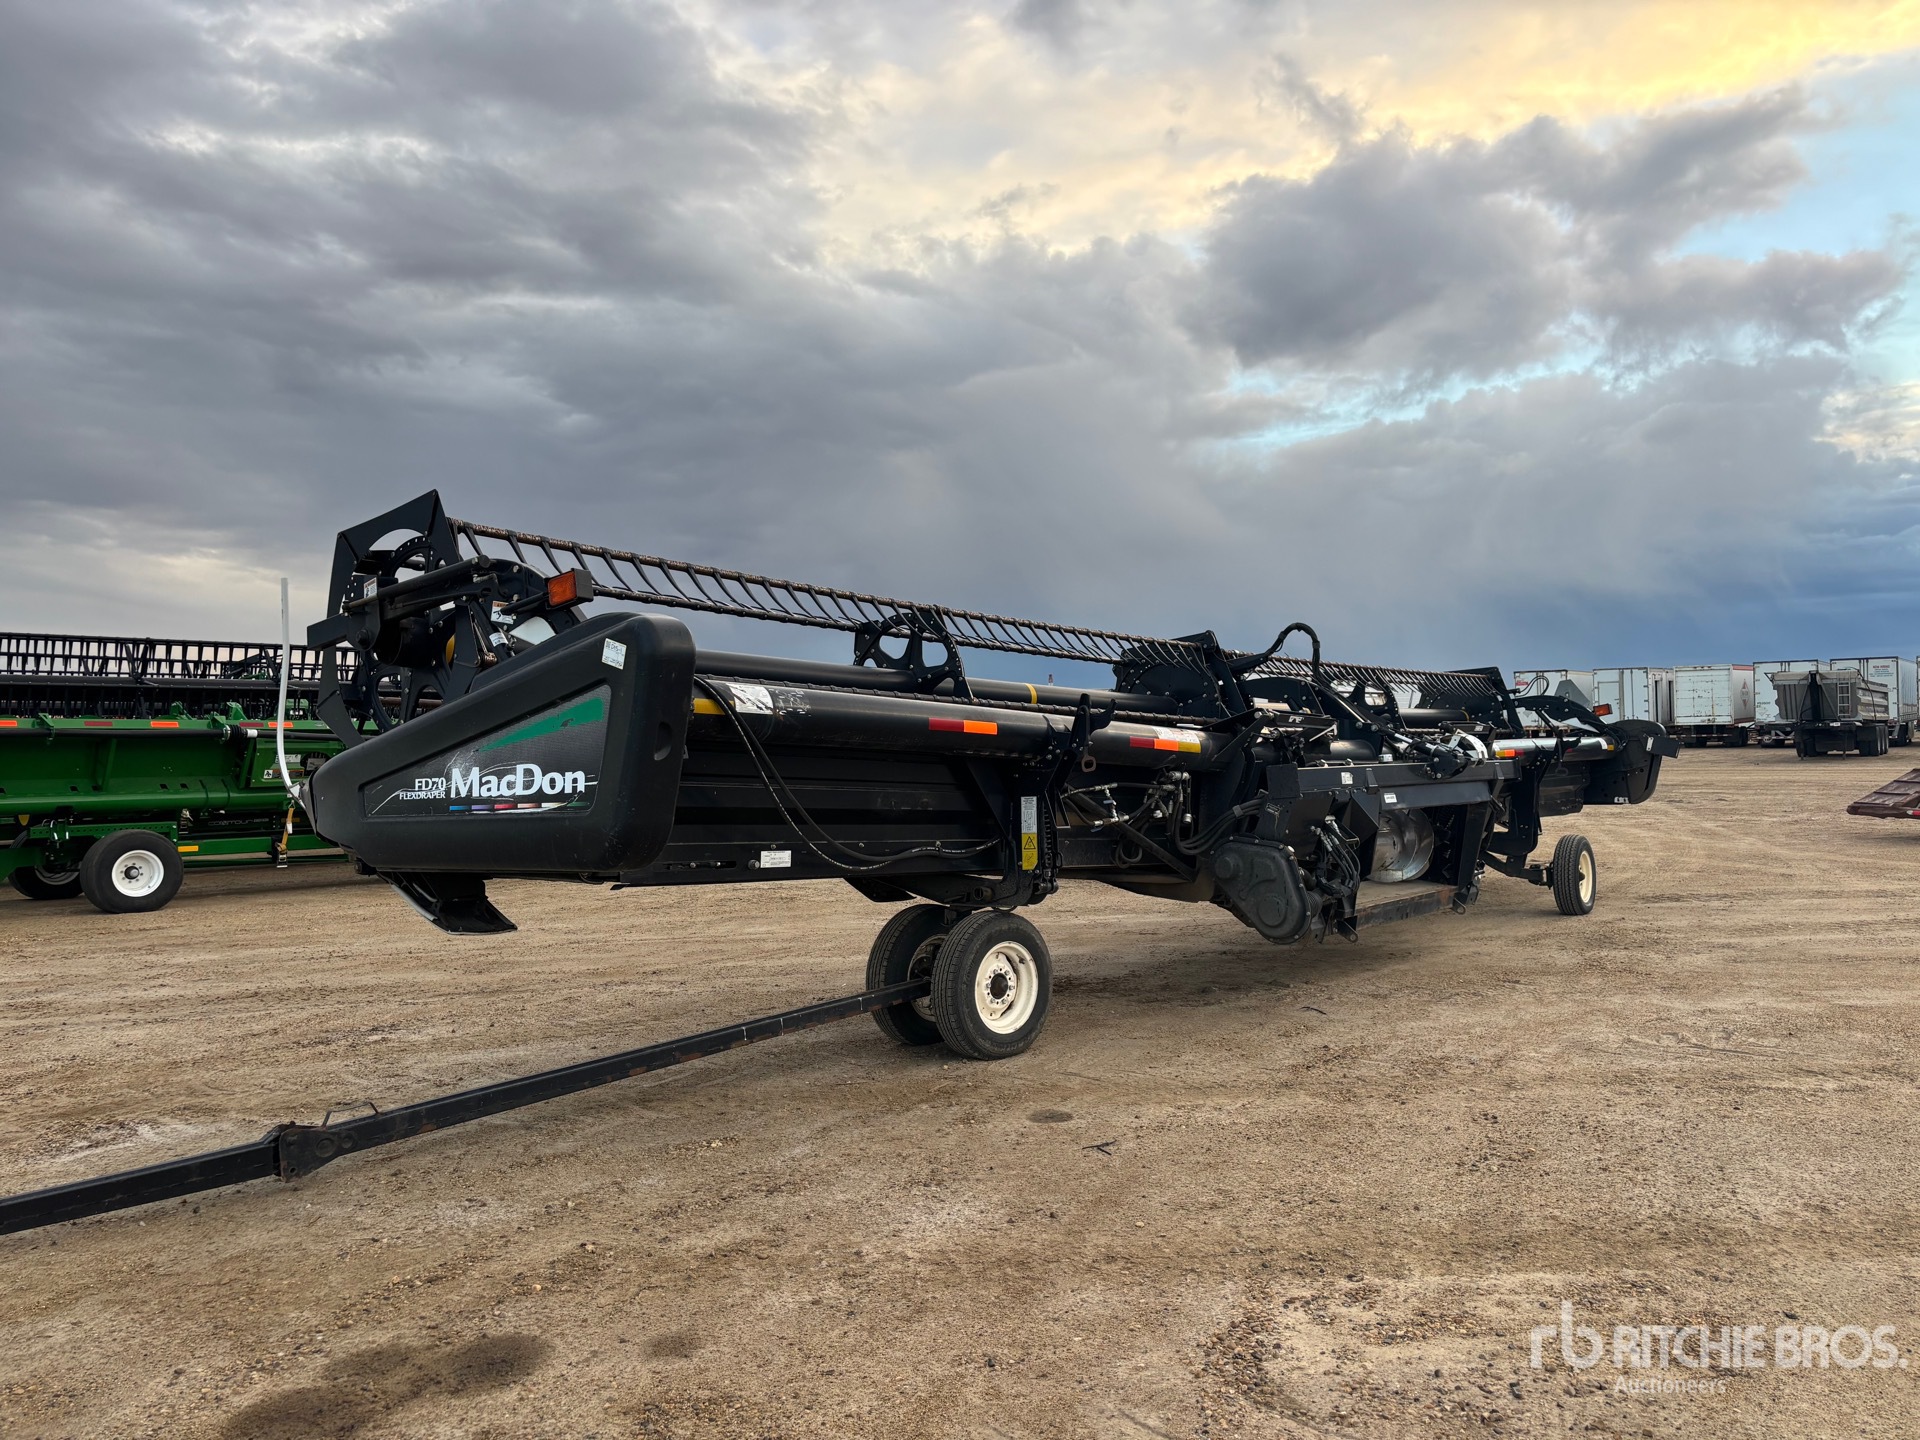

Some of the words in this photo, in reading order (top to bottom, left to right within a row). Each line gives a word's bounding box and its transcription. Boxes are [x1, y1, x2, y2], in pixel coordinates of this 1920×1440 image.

[414, 777, 447, 791] FD70
[450, 763, 586, 798] MacDon
[399, 790, 446, 800] FLEXDRAPER
